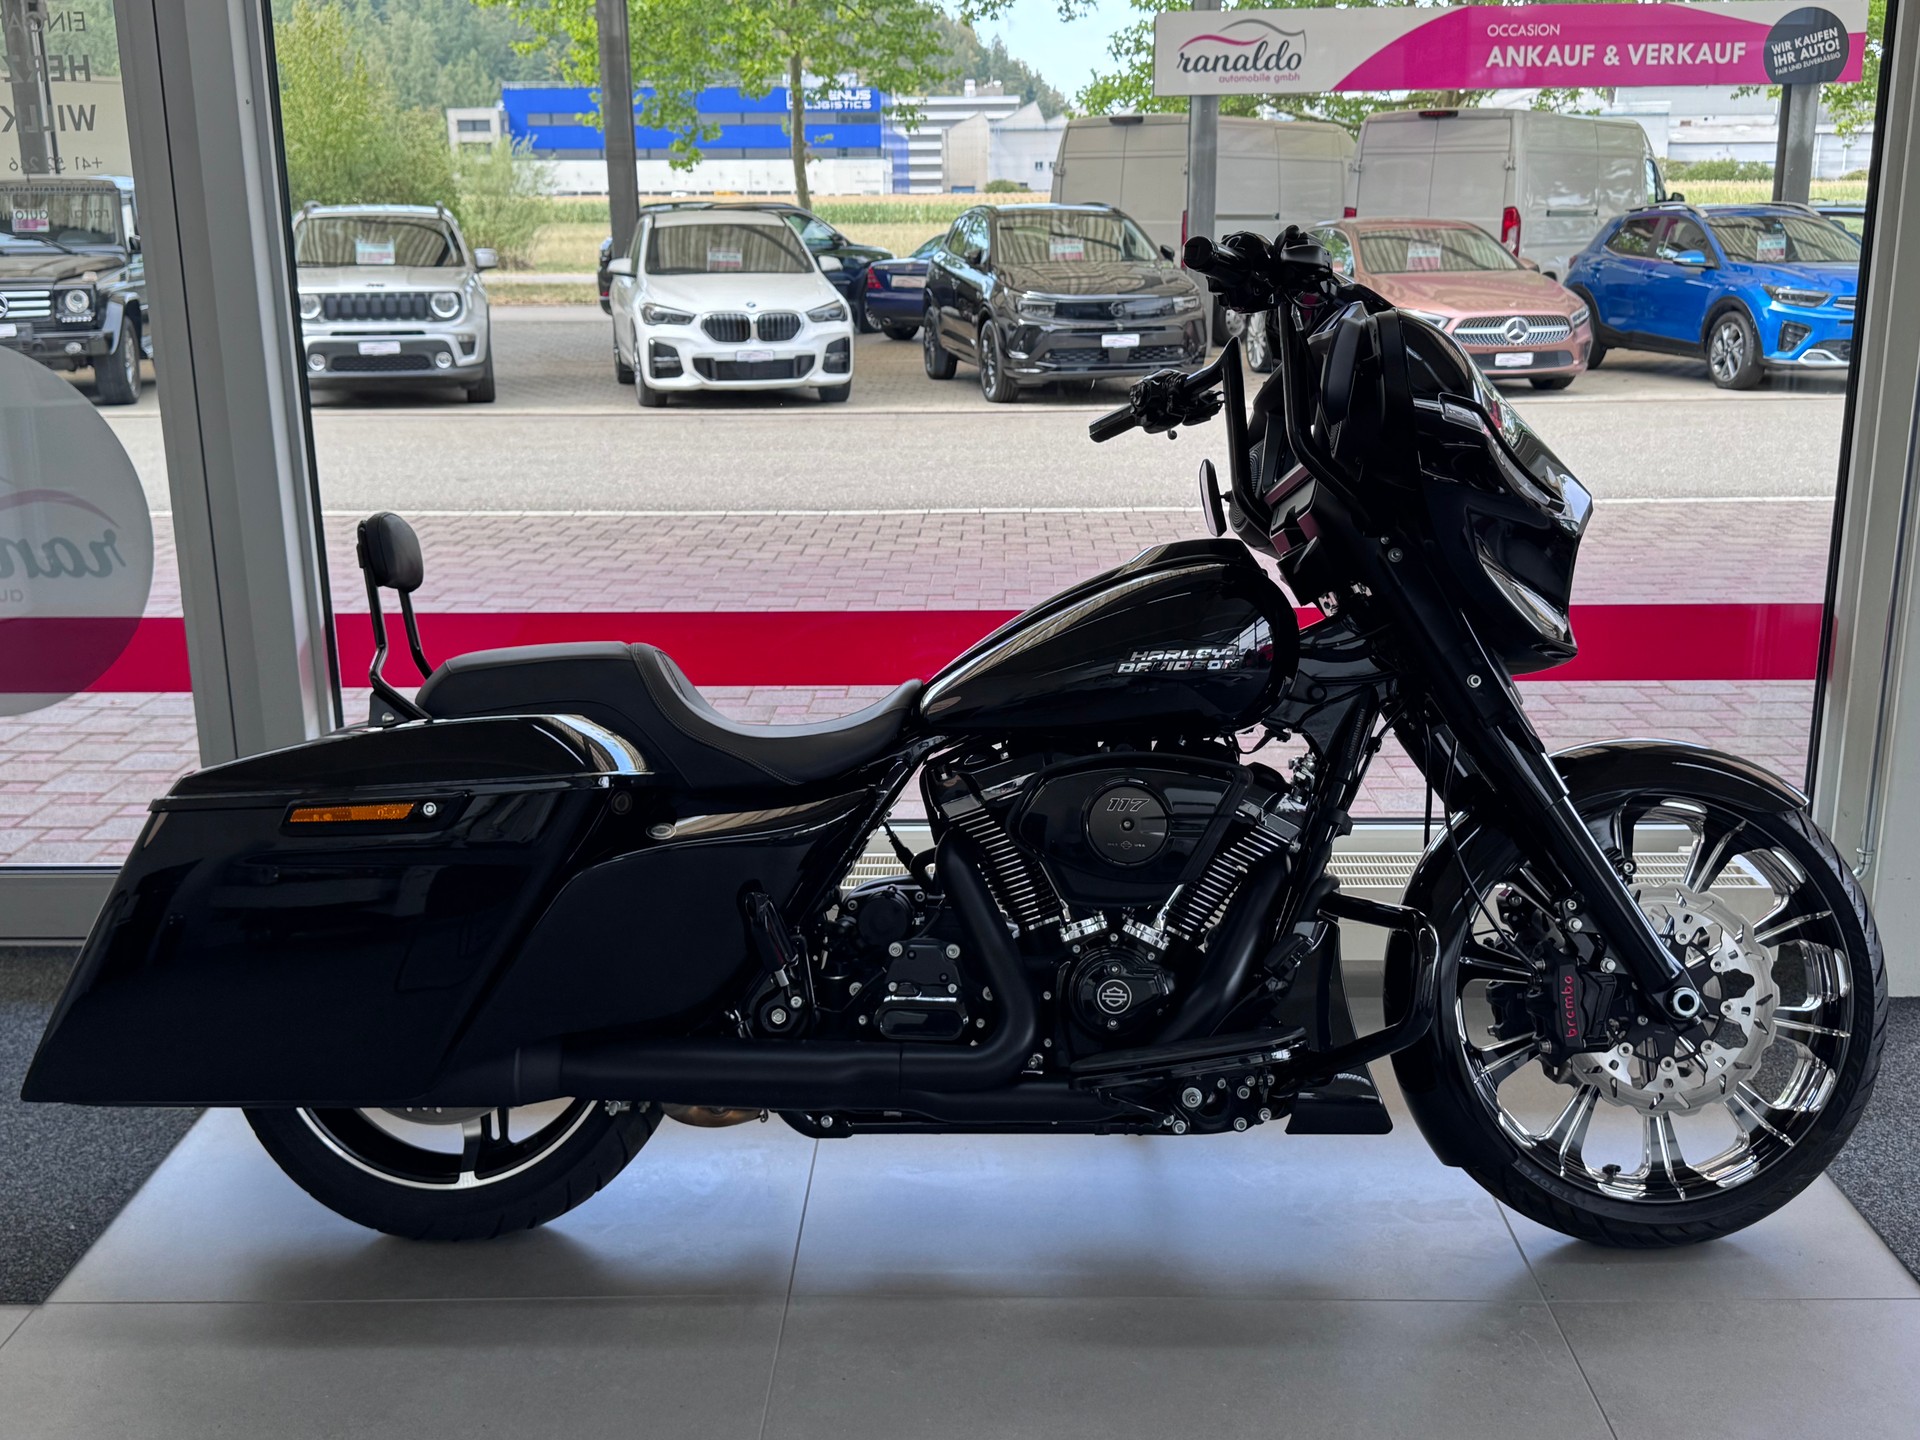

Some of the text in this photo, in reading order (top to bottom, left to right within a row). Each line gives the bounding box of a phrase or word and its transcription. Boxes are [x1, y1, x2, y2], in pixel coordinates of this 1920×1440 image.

[1487, 23, 1561, 37] OCCASION
[1771, 26, 1839, 55] WIR KAUFEN
[1176, 39, 1302, 73] ranaldo
[1485, 41, 1747, 68] ANKAUF & VERKAUF
[1773, 38, 1841, 68] IHR AUTO!
[1775, 51, 1841, 76] FAIR UND ZUVERLÄSSIG
[1218, 72, 1301, 84] automobile gmbh
[1117, 659, 1240, 673] DAVIDSON
[1106, 797, 1151, 812] 117
[1562, 975, 1577, 1038] brembo
